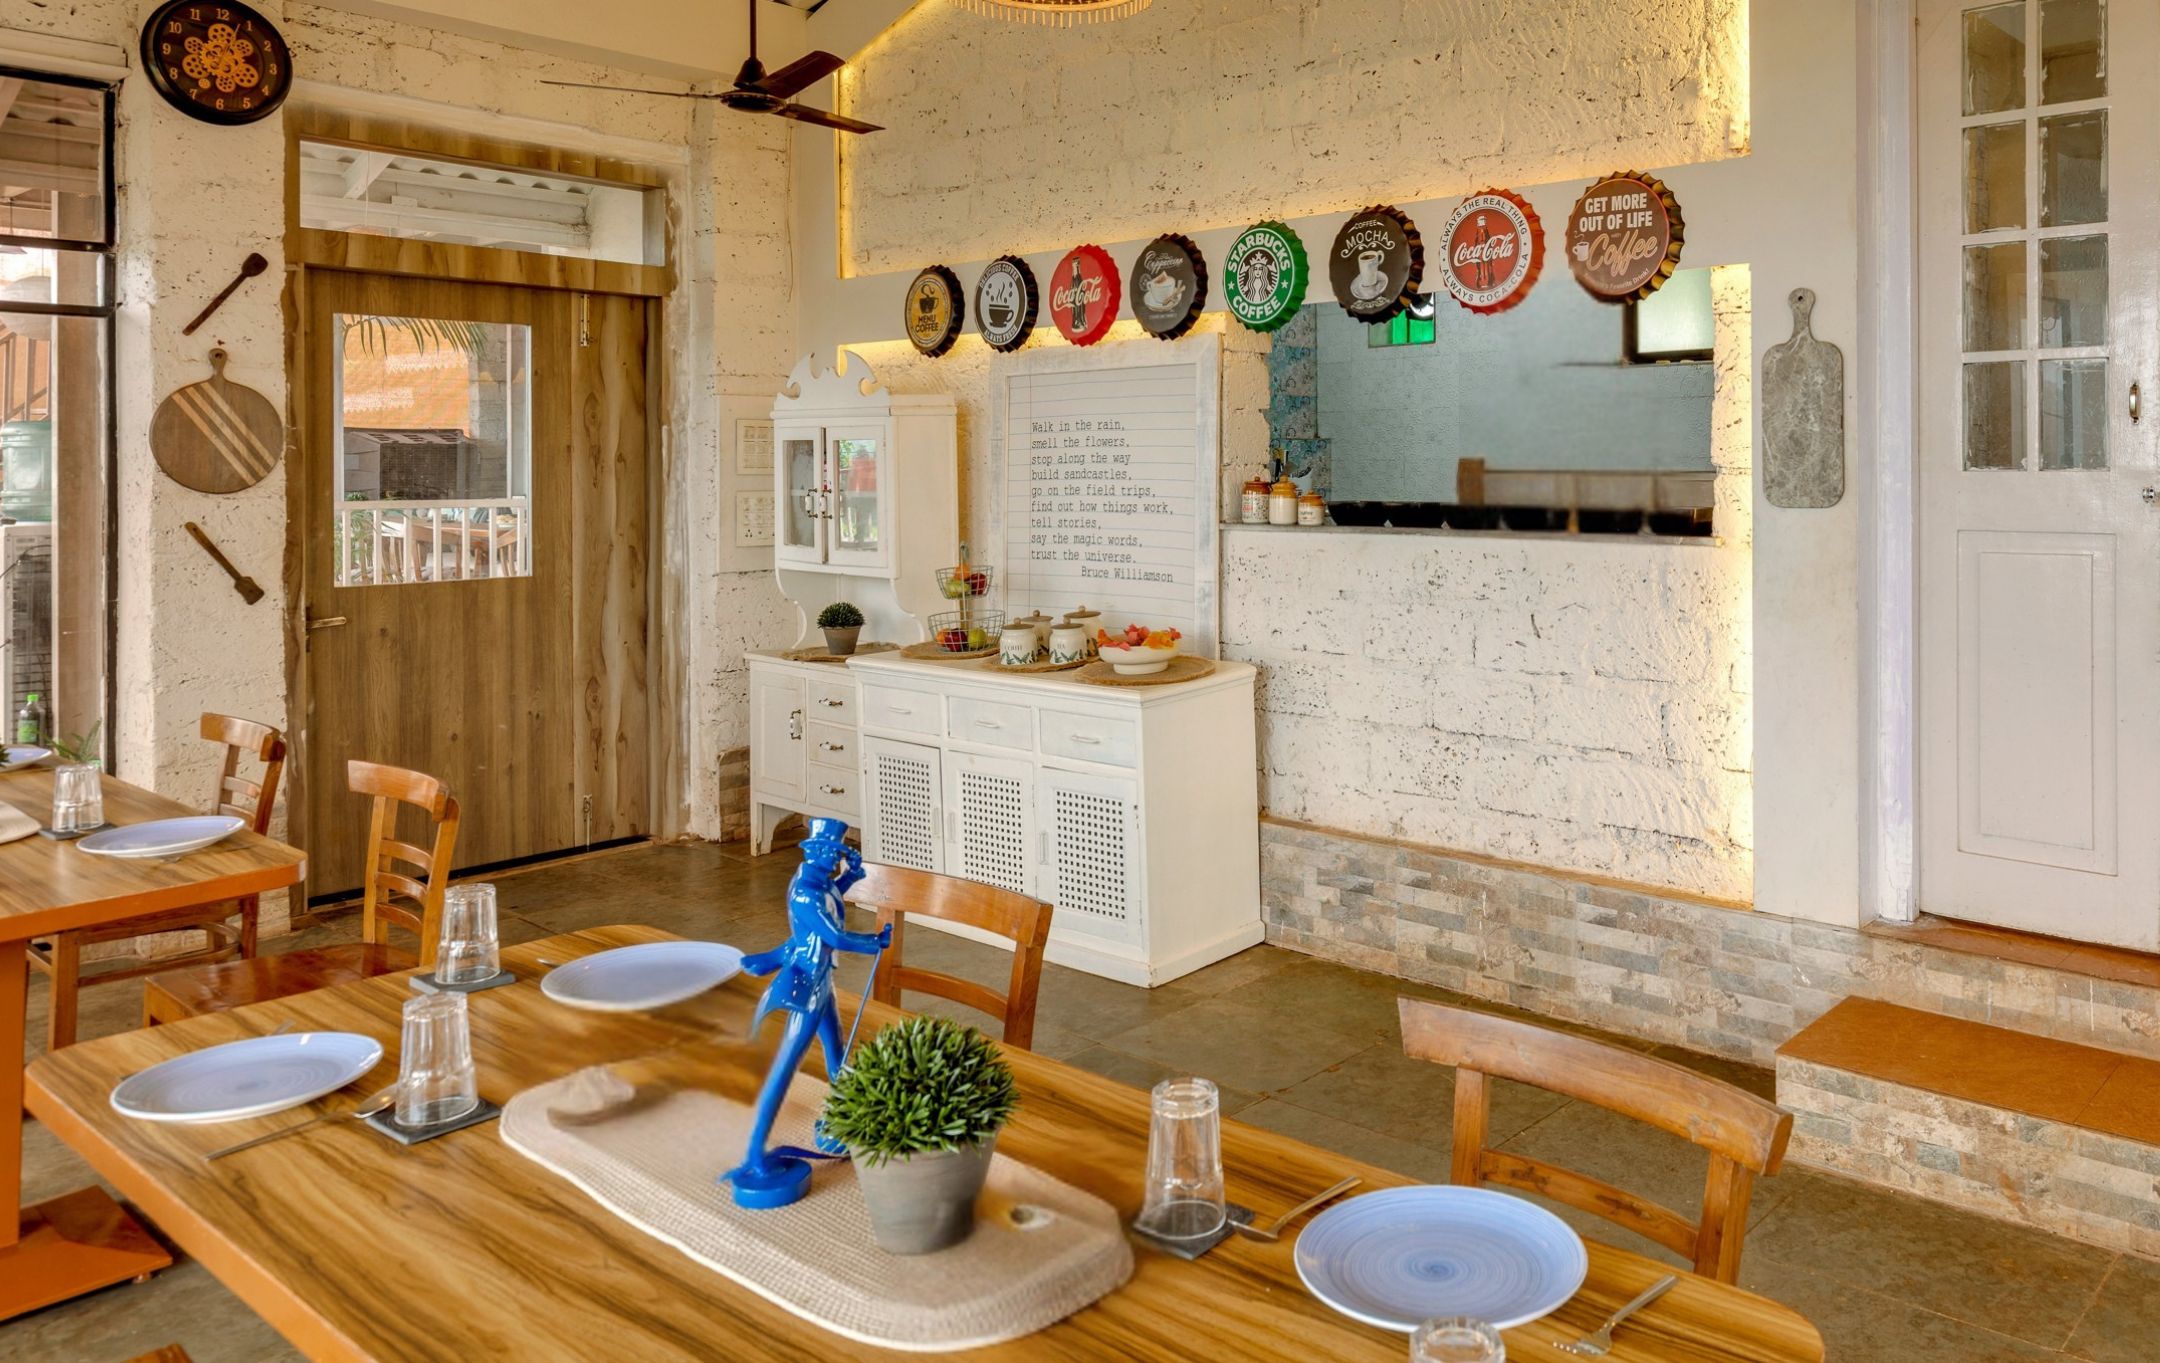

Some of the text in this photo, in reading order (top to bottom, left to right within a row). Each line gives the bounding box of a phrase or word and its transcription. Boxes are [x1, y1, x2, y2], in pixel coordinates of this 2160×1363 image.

[190, 9, 200, 20] 11
[216, 8, 230, 21] 12
[169, 21, 182, 34] 10
[246, 21, 253, 32] 1
[162, 43, 171, 55] 9
[264, 40, 272, 52] 2
[169, 67, 178, 80] 8
[269, 64, 277, 75] 3
[190, 88, 198, 100] 7
[262, 86, 270, 96] 4
[216, 98, 224, 110] 6
[243, 98, 251, 108] 5
[1585, 193, 1647, 214] GET MORE
[1354, 220, 1377, 229] COFFEE
[1441, 198, 1528, 250] ALWAYS THE REAL THING
[1580, 211, 1653, 233] OUT OF LIFE
[1346, 230, 1389, 249] MOCHA
[1228, 233, 1290, 272] STARBUCKS
[1586, 229, 1658, 277] Coffee
[1443, 253, 1529, 303] ALWAYS COCA-COLA
[1233, 296, 1281, 319] COFFEE
[918, 314, 936, 323] MENU
[915, 322, 939, 333] COFFEE
[1032, 421, 1053, 433] Walk
[1059, 421, 1070, 432] in
[1075, 419, 1092, 431] the
[1032, 437, 1057, 449] smell
[1063, 436, 1080, 447] the
[1032, 452, 1131, 466] stop along the way
[1032, 469, 1059, 480] build
[1032, 487, 1042, 498] go
[1048, 487, 1059, 496] on
[1064, 484, 1080, 496] the
[1086, 483, 1115, 496] field
[1031, 500, 1053, 512] find
[1057, 502, 1074, 512] out
[1079, 500, 1097, 512] how
[1103, 501, 1138, 515] things
[1031, 517, 1053, 528] tell
[1031, 534, 1047, 545] say
[1053, 533, 1069, 544] the
[1073, 533, 1103, 547] magic
[1031, 550, 1057, 560] trust
[1063, 549, 1079, 560] the
[1081, 566, 1173, 583] Bruce Williamson
